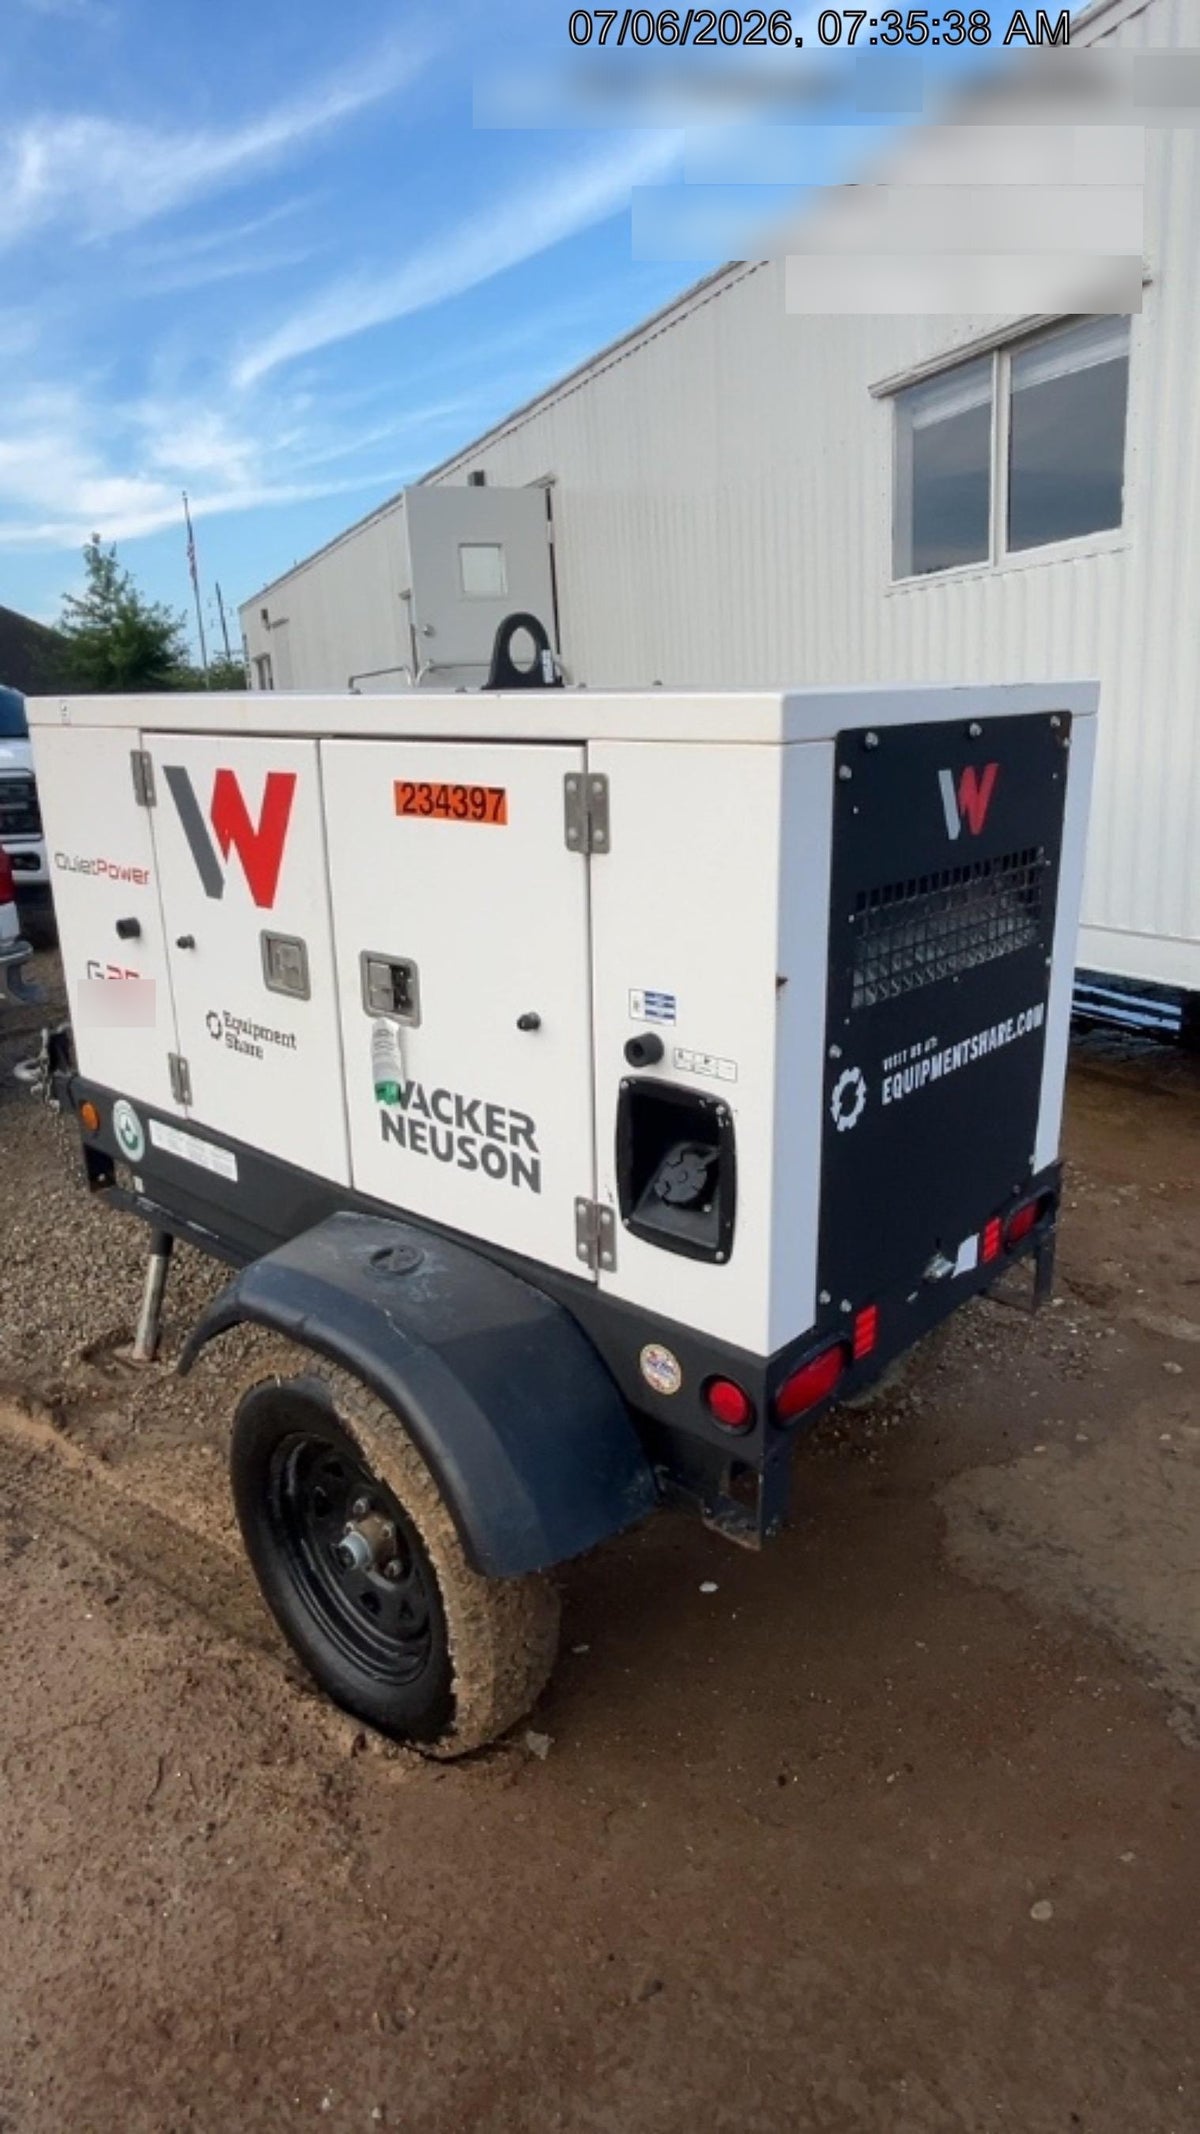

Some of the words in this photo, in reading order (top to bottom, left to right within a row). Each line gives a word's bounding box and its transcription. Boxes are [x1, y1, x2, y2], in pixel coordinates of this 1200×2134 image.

[400, 782, 505, 821] 234397
[222, 1009, 297, 1051] Equipment
[225, 1031, 264, 1060] Share
[881, 1002, 1045, 1106] EQUIPMENTSHARE.COM
[380, 1108, 542, 1195] NEUSON
